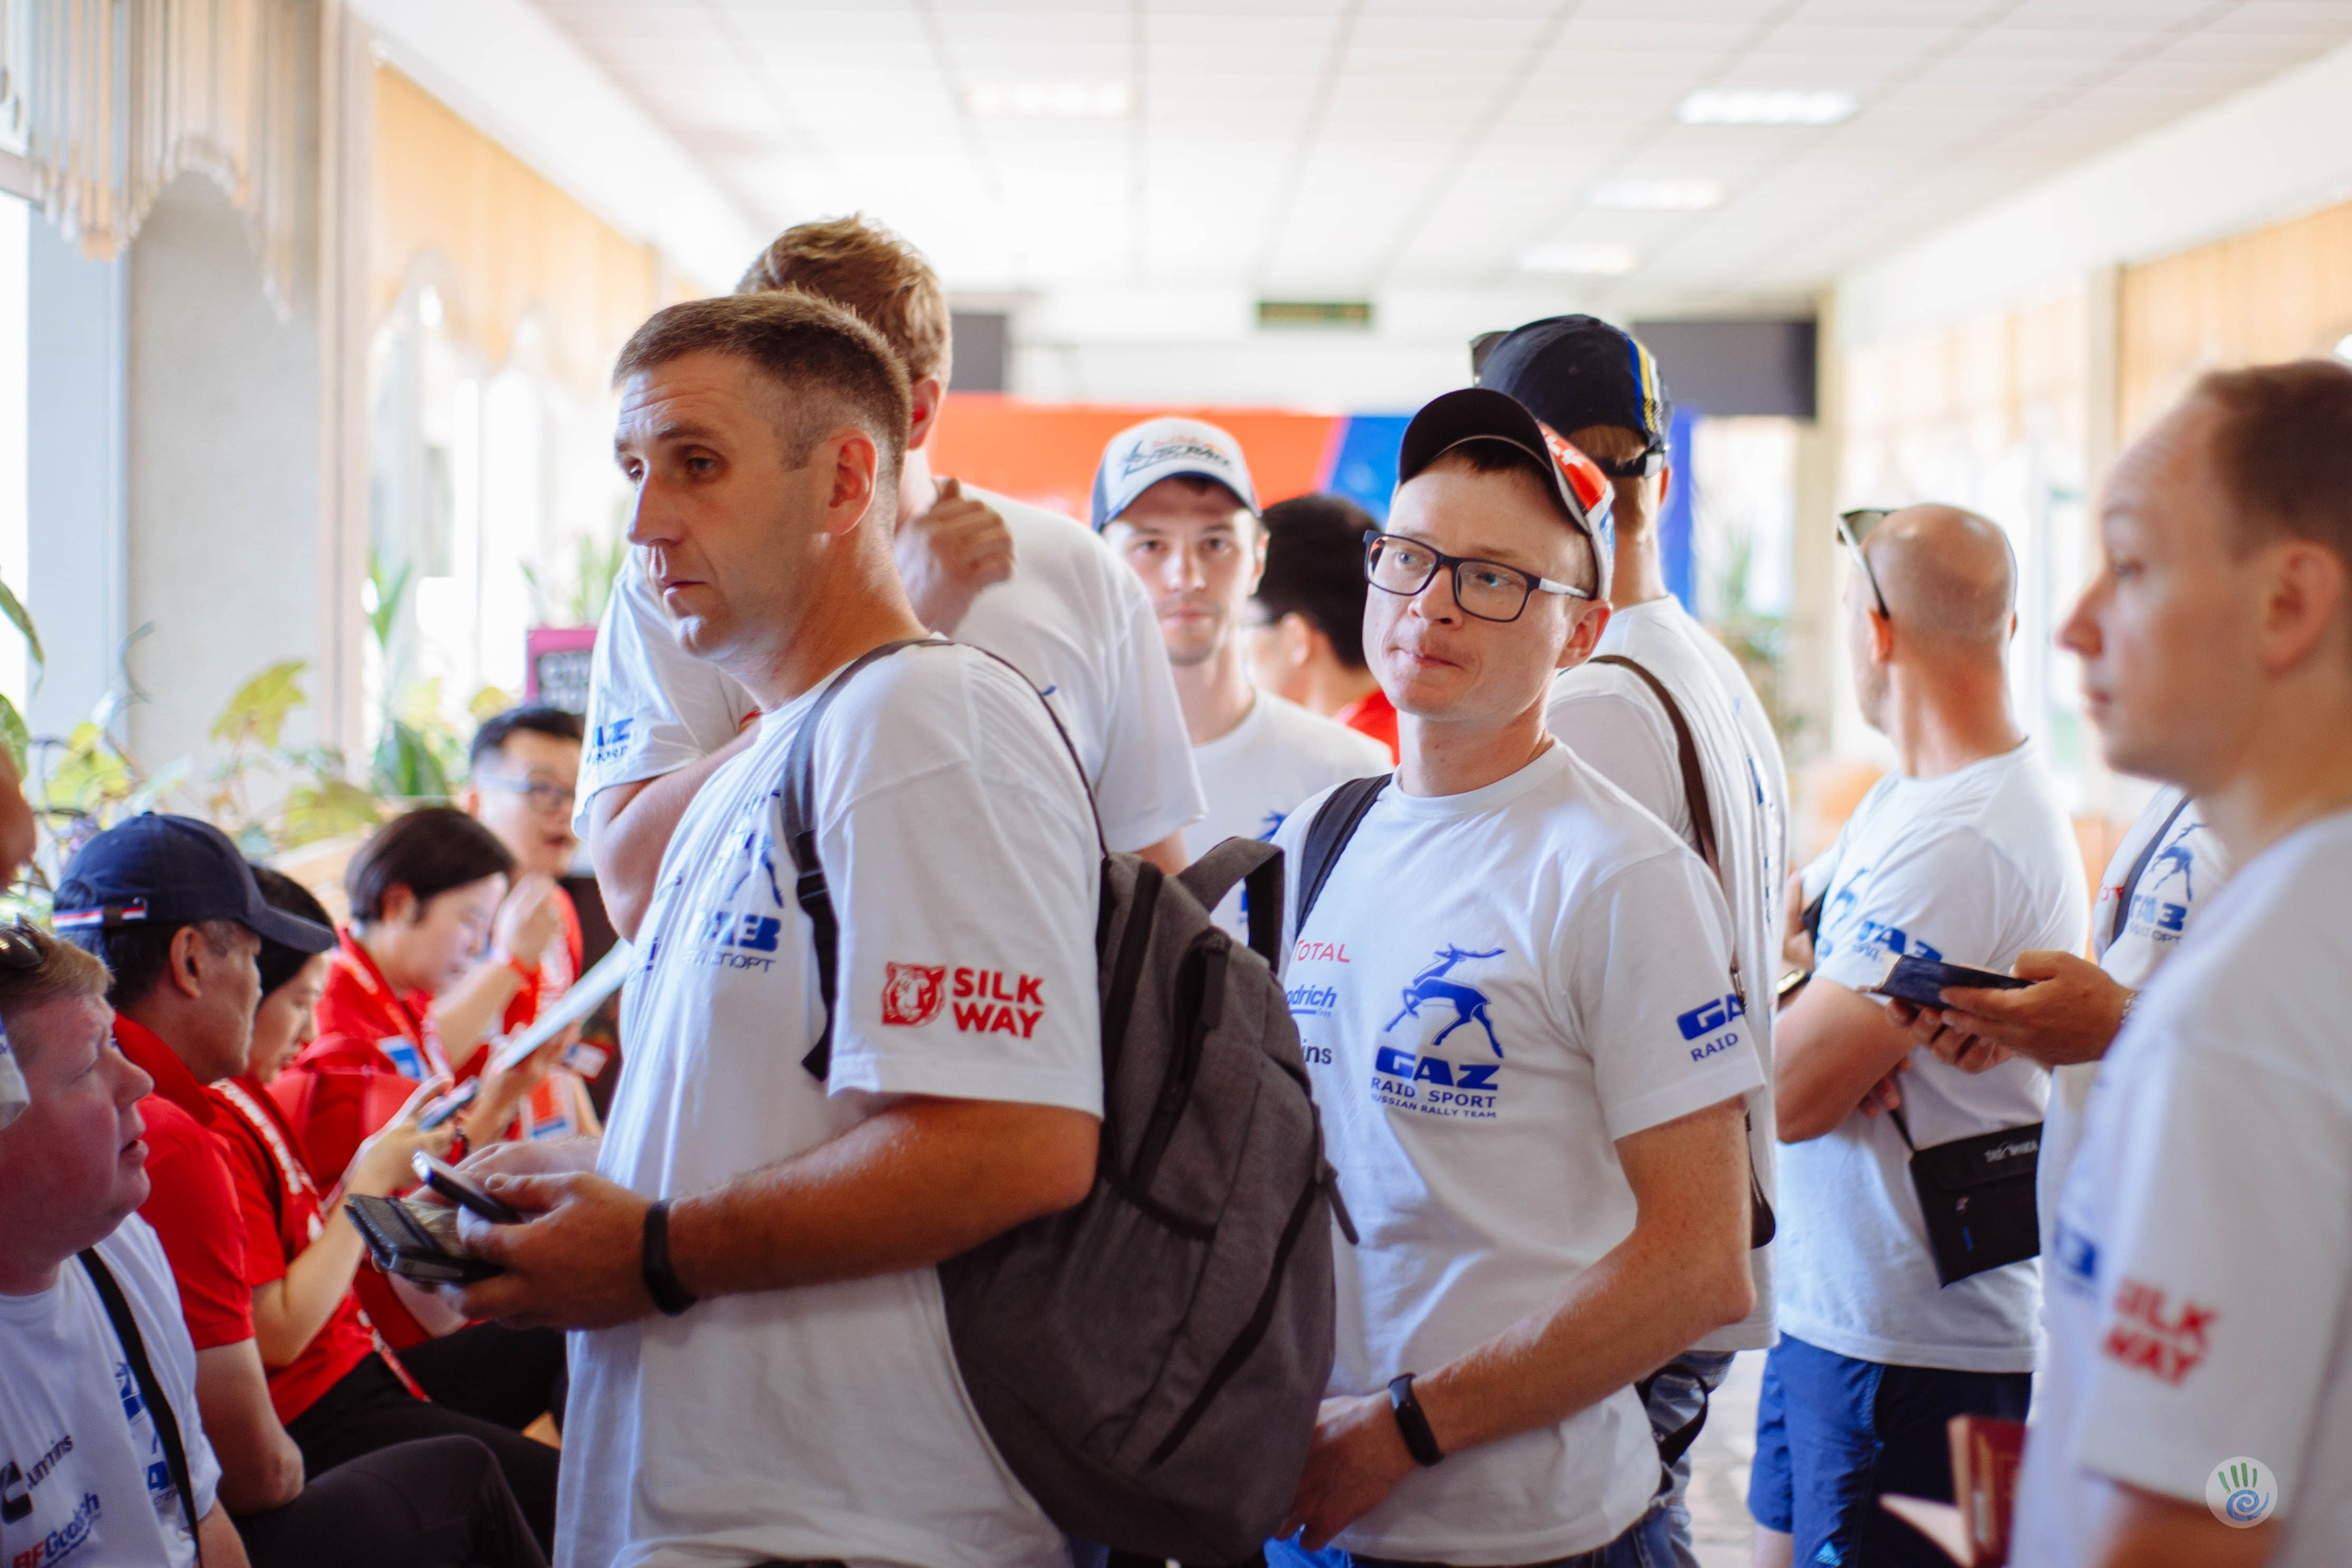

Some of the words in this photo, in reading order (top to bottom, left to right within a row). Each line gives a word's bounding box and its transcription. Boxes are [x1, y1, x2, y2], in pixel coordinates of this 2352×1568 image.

[952, 966, 1045, 1007] SILK
[1285, 983, 1338, 1008] odrich
[952, 1000, 1046, 1040] WAY
[1677, 993, 1745, 1041] GA
[1690, 1032, 1739, 1063] RAID
[1375, 1045, 1500, 1091] GAZ
[1371, 1077, 1416, 1099] RAID
[1428, 1089, 1498, 1109] SPORT
[1420, 1104, 1459, 1117] RALLY
[1463, 1110, 1498, 1119] TEAM
